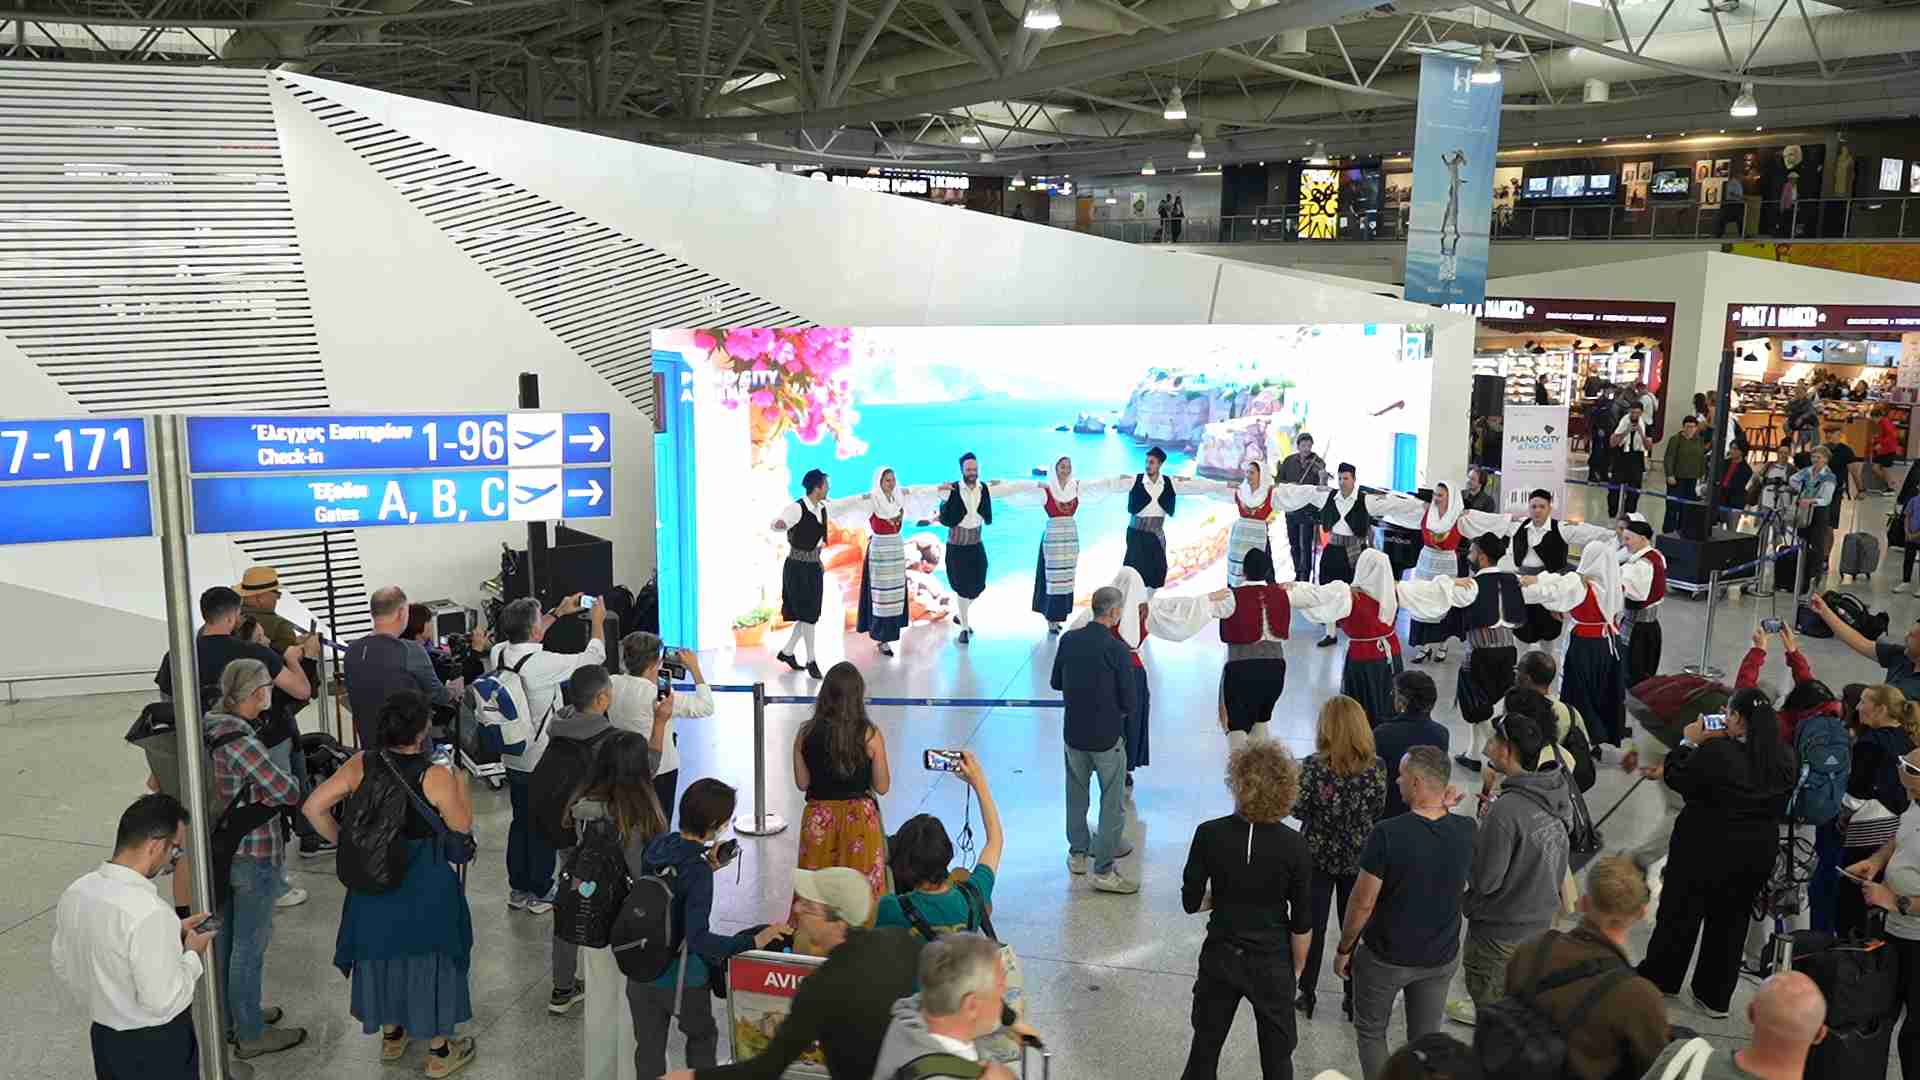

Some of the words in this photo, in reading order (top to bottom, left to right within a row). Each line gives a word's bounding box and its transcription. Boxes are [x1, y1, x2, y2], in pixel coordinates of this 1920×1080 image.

[422, 420, 505, 461] 1-96
[258, 448, 324, 465] Check-in
[314, 506, 360, 523] Gates
[378, 480, 418, 524] A,
[432, 479, 468, 522] B,
[480, 477, 505, 517] C
